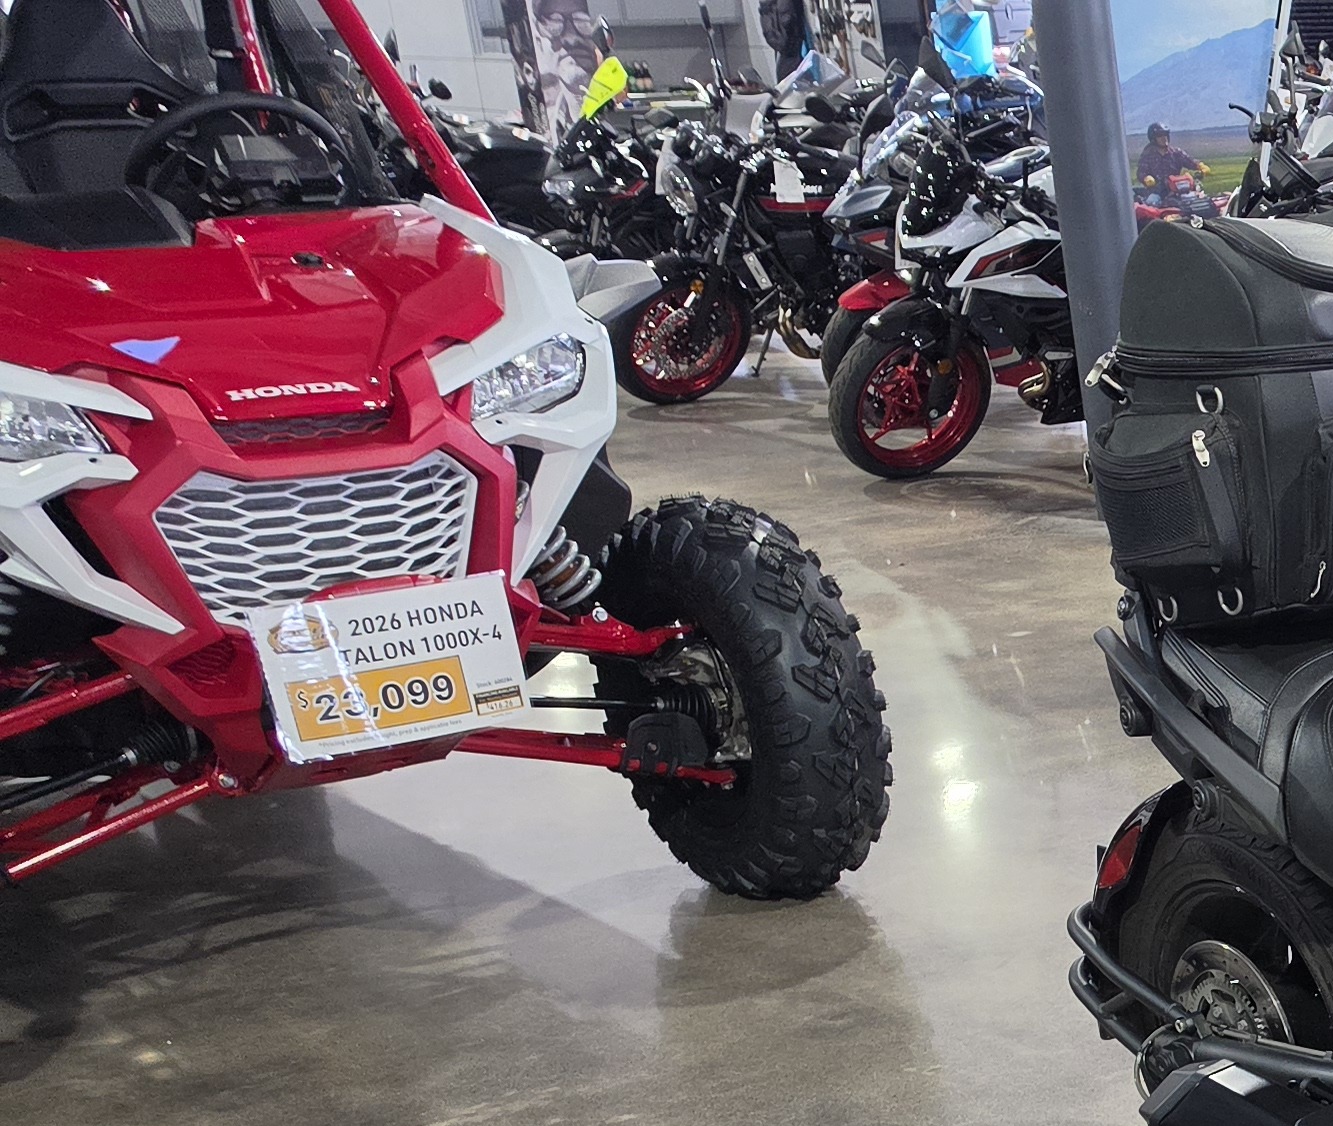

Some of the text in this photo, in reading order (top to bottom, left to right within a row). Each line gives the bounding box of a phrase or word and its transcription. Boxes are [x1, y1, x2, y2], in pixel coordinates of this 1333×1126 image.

[225, 381, 361, 401] HONDA
[348, 613, 402, 636] 2026
[406, 600, 484, 627] HONDA
[340, 624, 502, 666] TALON 1000X-4
